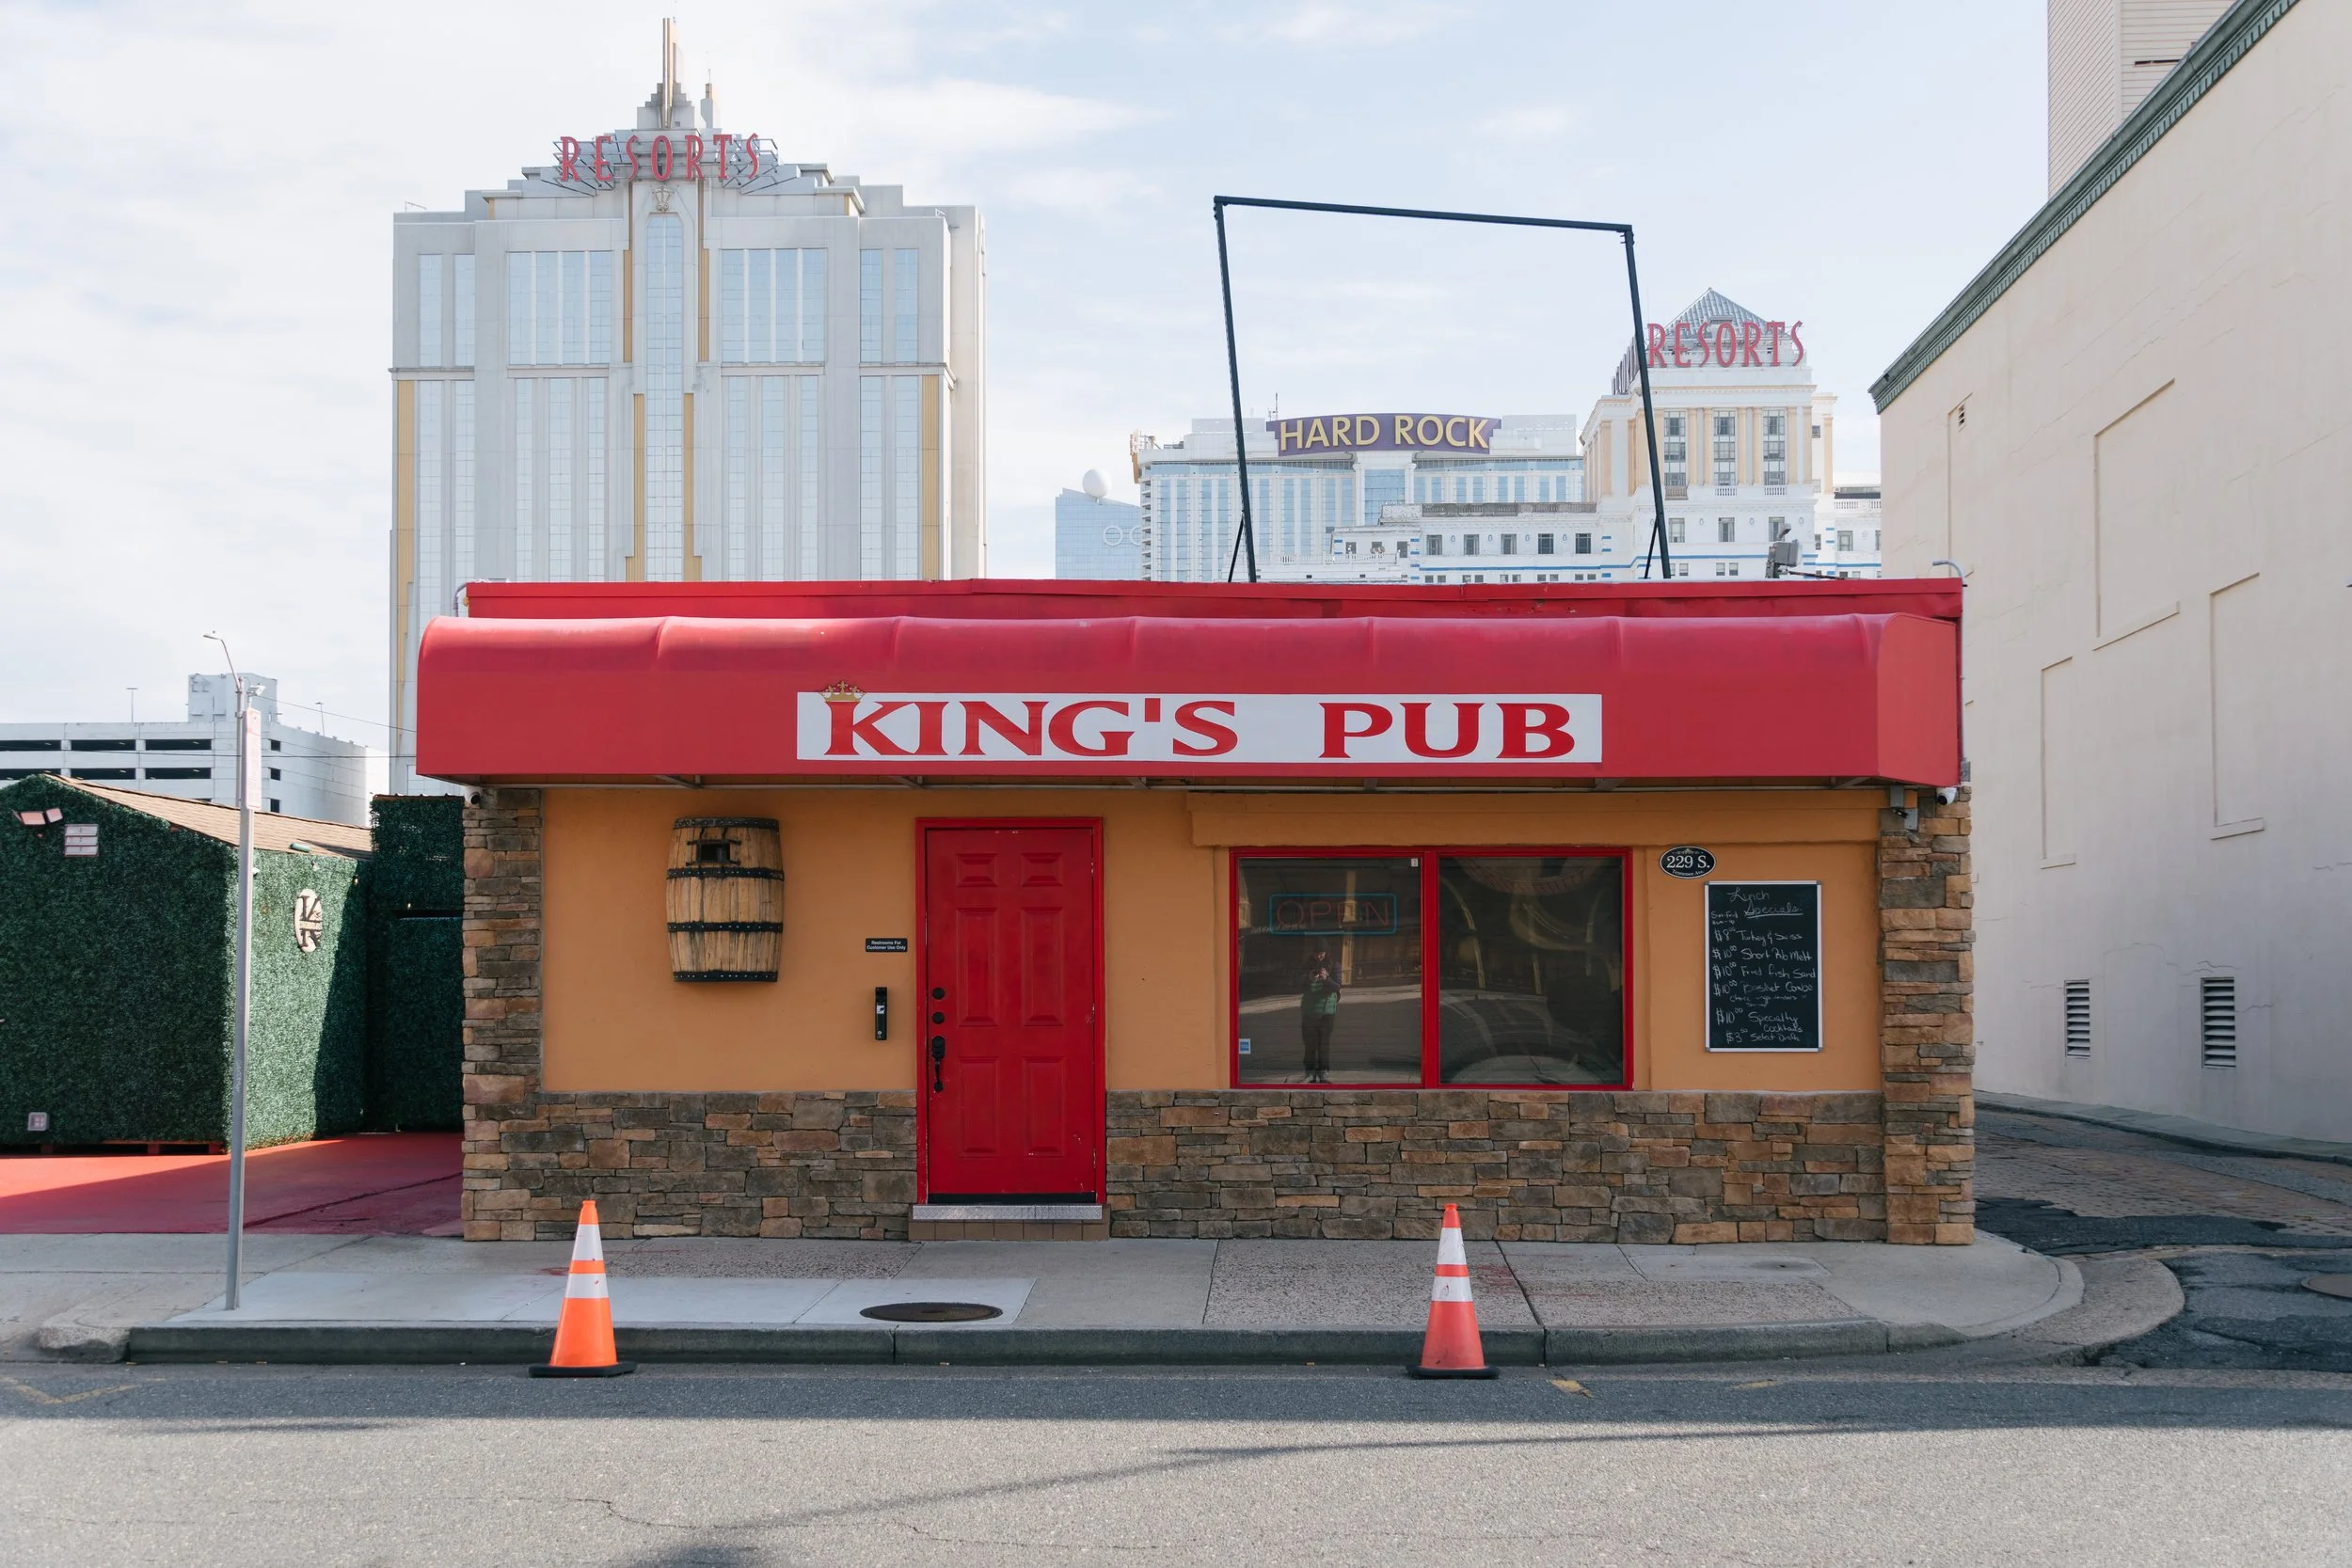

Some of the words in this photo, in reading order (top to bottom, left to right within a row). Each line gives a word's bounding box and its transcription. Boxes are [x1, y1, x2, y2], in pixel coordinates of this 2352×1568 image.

[561, 133, 759, 182] RESORTS
[1646, 320, 1804, 369] RESORTS
[1280, 416, 1381, 451] HARD
[1394, 415, 1490, 449] ROCK
[823, 698, 1239, 757] KING'S
[1318, 702, 1577, 760] PUB
[1666, 855, 1694, 869] 229
[1697, 855, 1710, 869] S.
[1277, 899, 1390, 928] OPEN
[1736, 929, 1766, 946] Turkey
[1774, 932, 1804, 941] Swiss
[1740, 947, 1770, 960] Short
[1772, 947, 1788, 960] Rib
[1789, 951, 1812, 961] Melt
[1740, 965, 1763, 977] Fried
[1792, 968, 1817, 979] Sand
[1747, 1011, 1798, 1026] Specialty
[1763, 1023, 1804, 1033] Cocktails
[1750, 1033, 1775, 1042] Select
